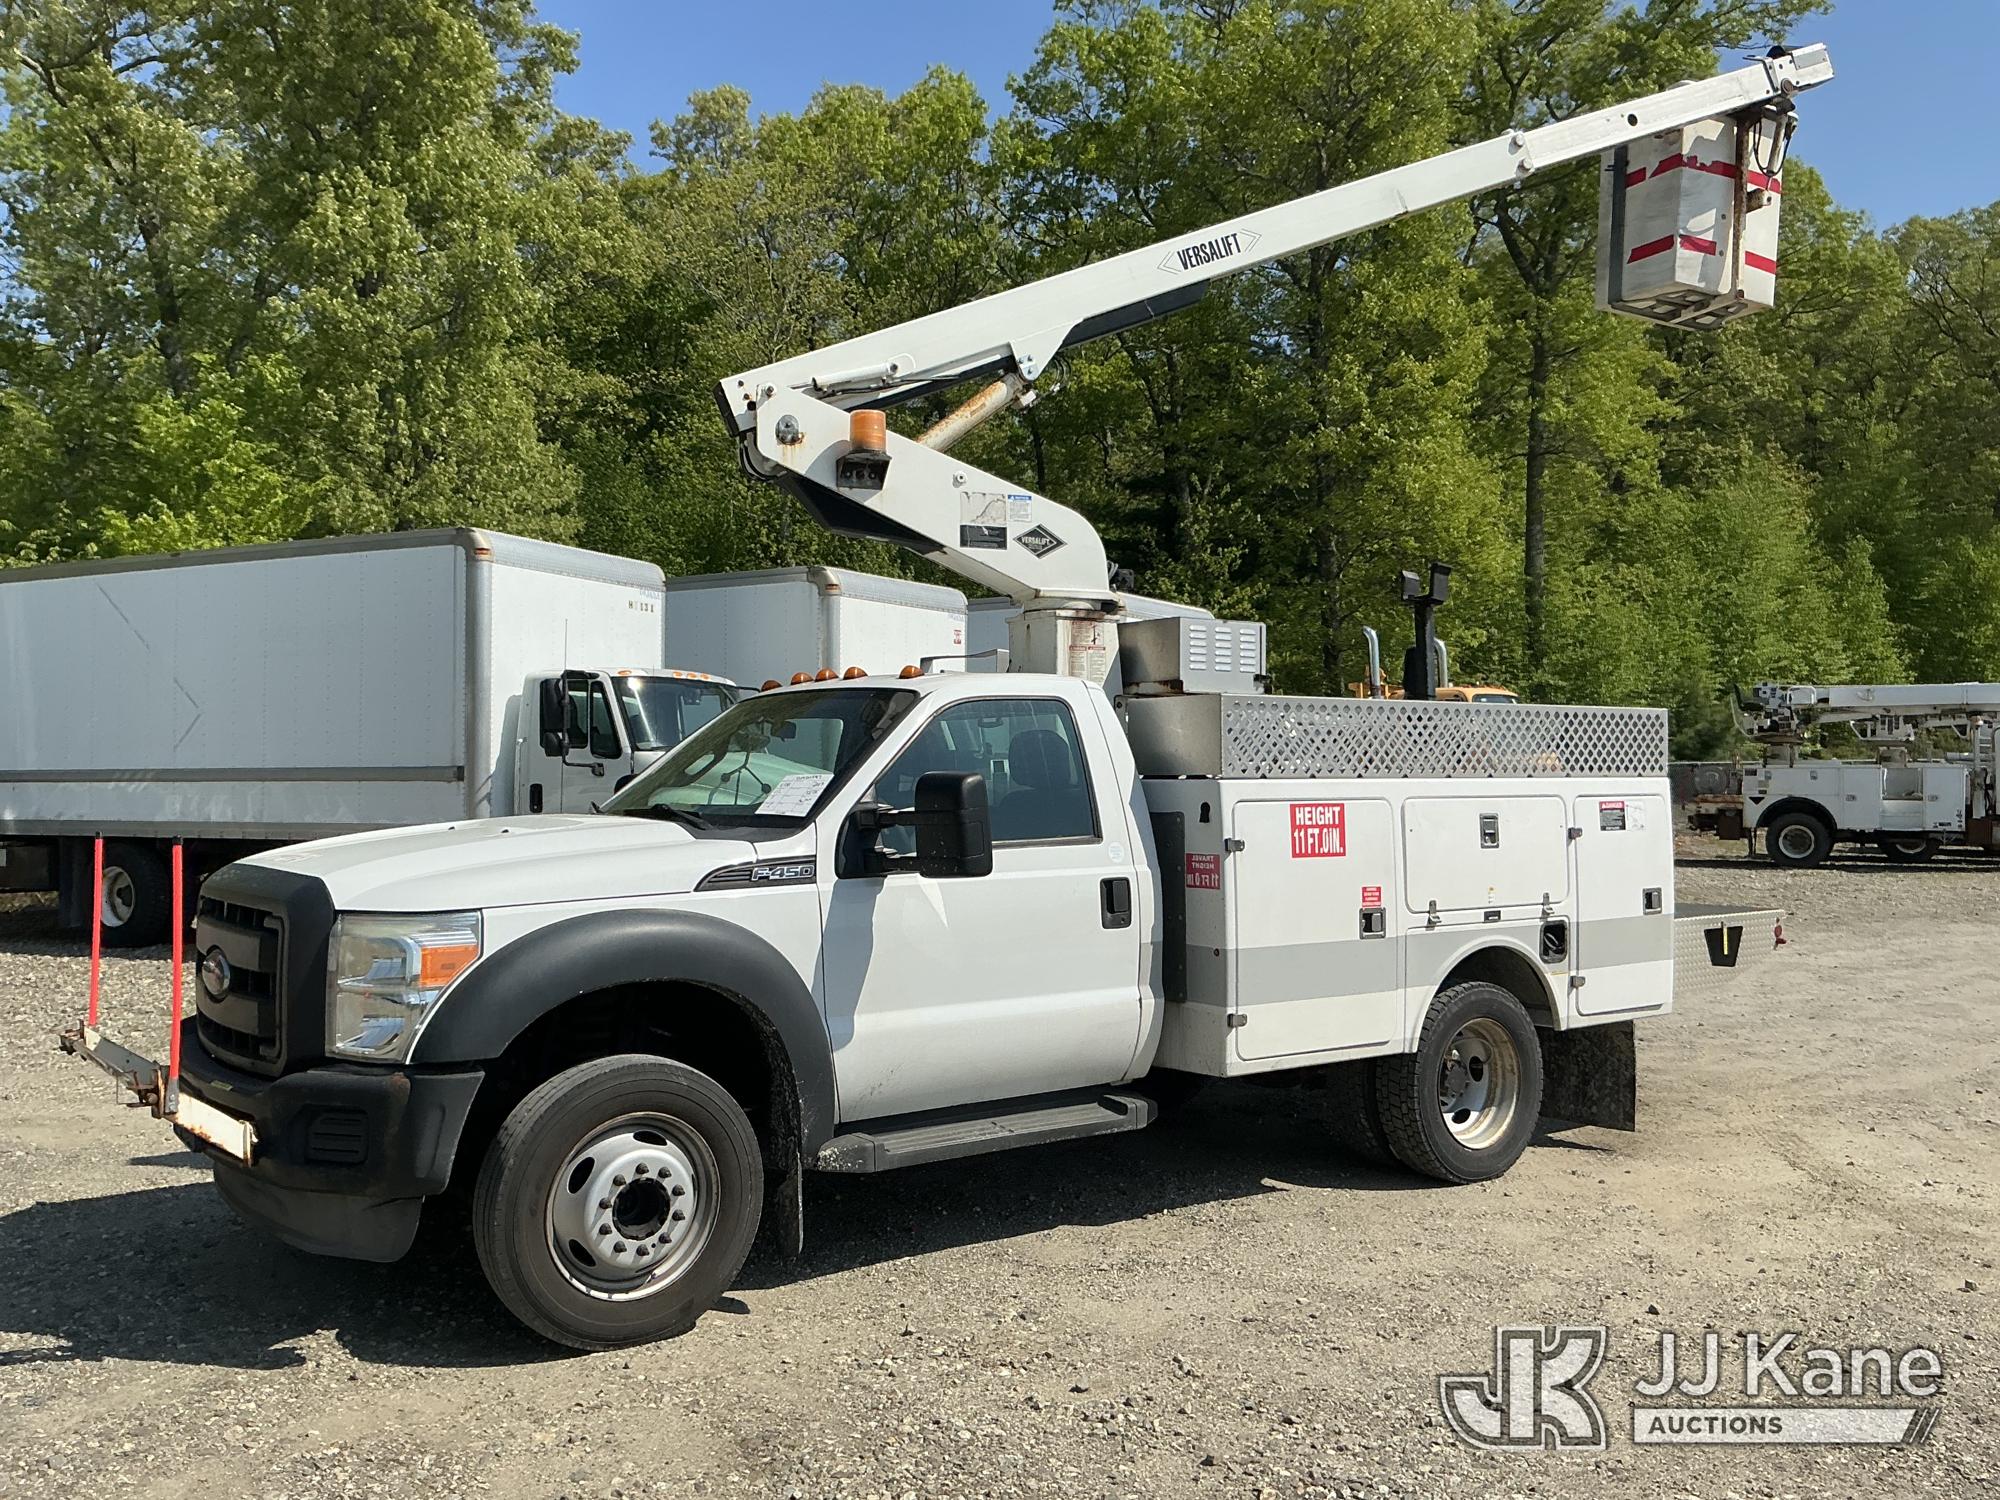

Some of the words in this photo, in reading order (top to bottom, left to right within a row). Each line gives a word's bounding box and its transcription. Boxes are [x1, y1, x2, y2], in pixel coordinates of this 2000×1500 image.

[1177, 233, 1241, 270] VERSALIFT
[1021, 536, 1050, 545] VERSALIFT
[1295, 806, 1340, 825] HEIGHT
[751, 865, 815, 881] F-450
